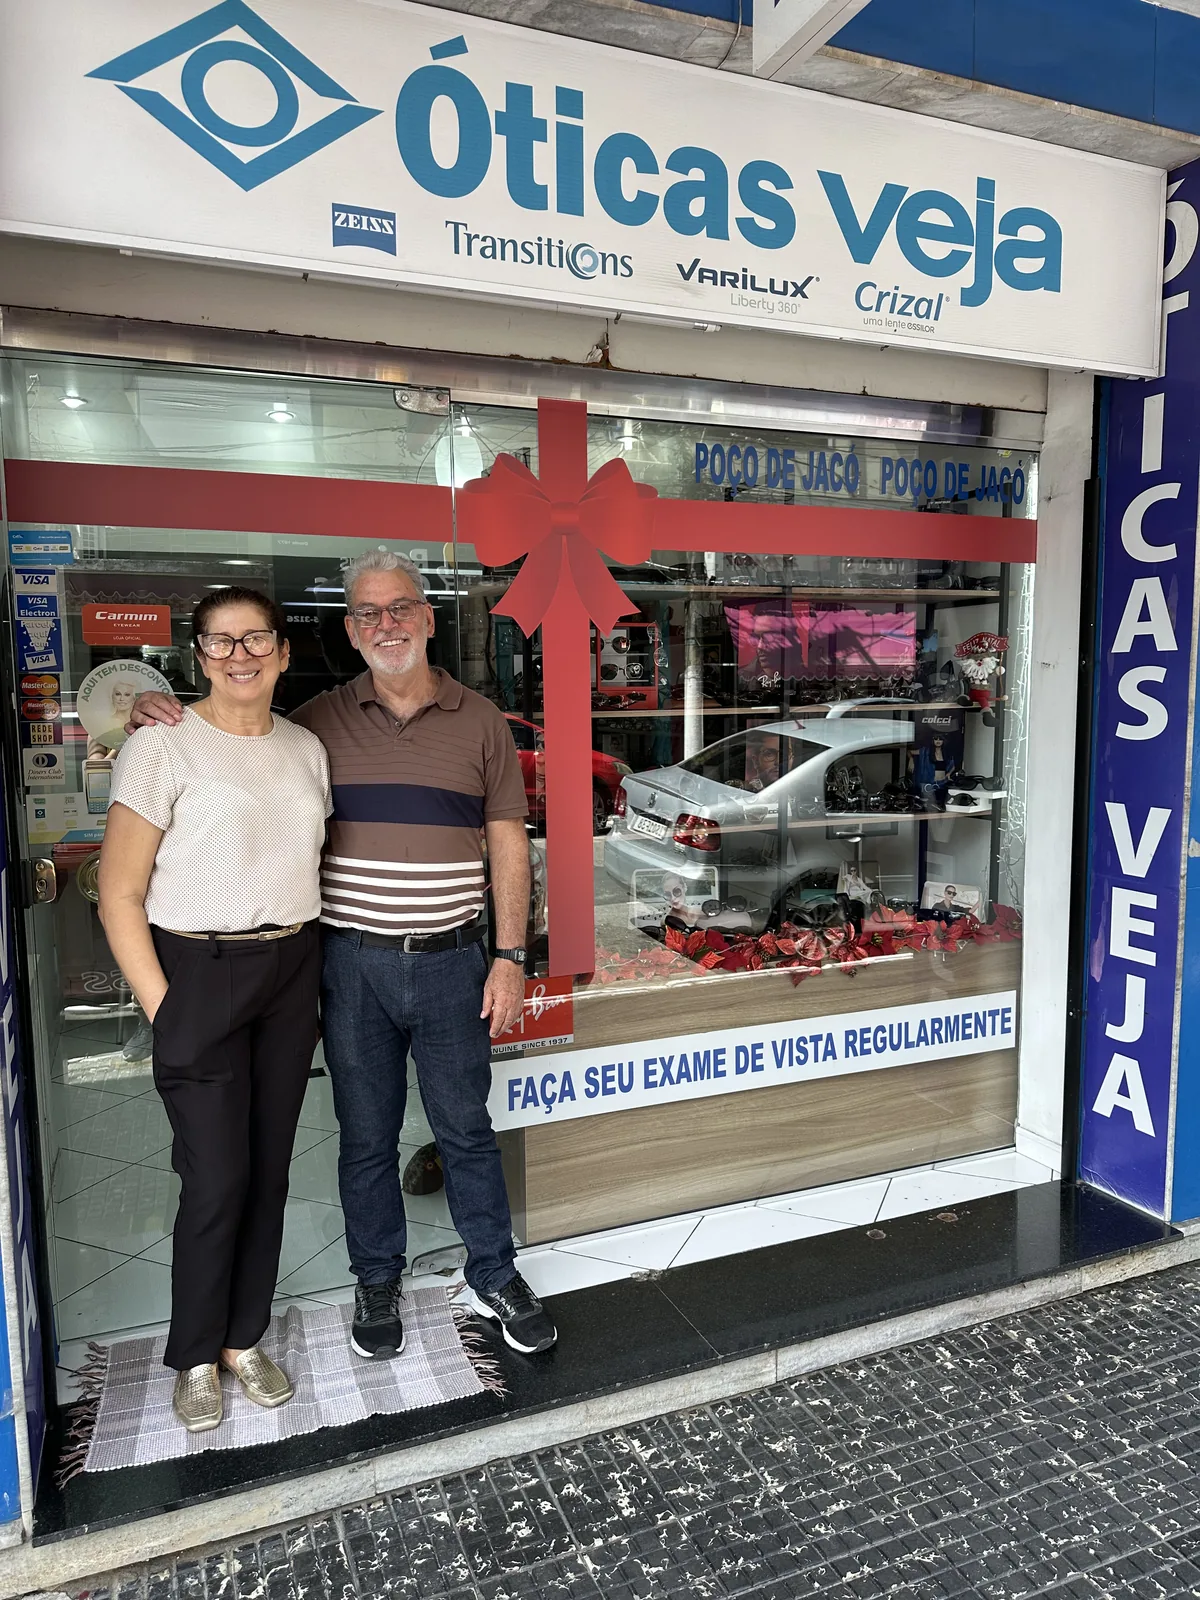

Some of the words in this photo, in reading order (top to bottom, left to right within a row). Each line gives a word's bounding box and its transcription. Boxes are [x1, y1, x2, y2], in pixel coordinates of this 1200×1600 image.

[395, 34, 796, 249] Óticas
[816, 169, 1062, 308] veja
[334, 211, 394, 235] ZEISS
[445, 220, 634, 280] Transitions
[730, 293, 775, 313] Liberty
[863, 317, 883, 326] uma
[885, 318, 906, 329] lente
[695, 443, 759, 497] POÇO
[767, 448, 795, 489] DE
[802, 444, 860, 494] JACÓ
[881, 457, 937, 507] POÇO
[945, 462, 970, 499] DE
[975, 460, 1025, 505] JACÓ
[22, 574, 50, 585] VISA
[20, 609, 56, 617] Electron
[95, 611, 158, 621] Carmim
[31, 655, 51, 664] VISA
[81, 677, 98, 702] AQUI
[95, 664, 118, 679] TEM
[31, 724, 52, 733] REDE
[922, 715, 952, 724] colcci
[32, 734, 53, 742] SHOP
[1091, 801, 1172, 1138] VEJA
[492, 1044, 519, 1054] NUINE
[521, 1040, 546, 1049] SINCE
[549, 1037, 568, 1046] 1937
[507, 1073, 576, 1115] FAÇA
[584, 1063, 635, 1098] SEU
[642, 1048, 727, 1088] EXAME
[735, 1042, 765, 1075] DE
[771, 1033, 838, 1069] VISTA
[844, 1006, 1012, 1059] REGULARMENTE
